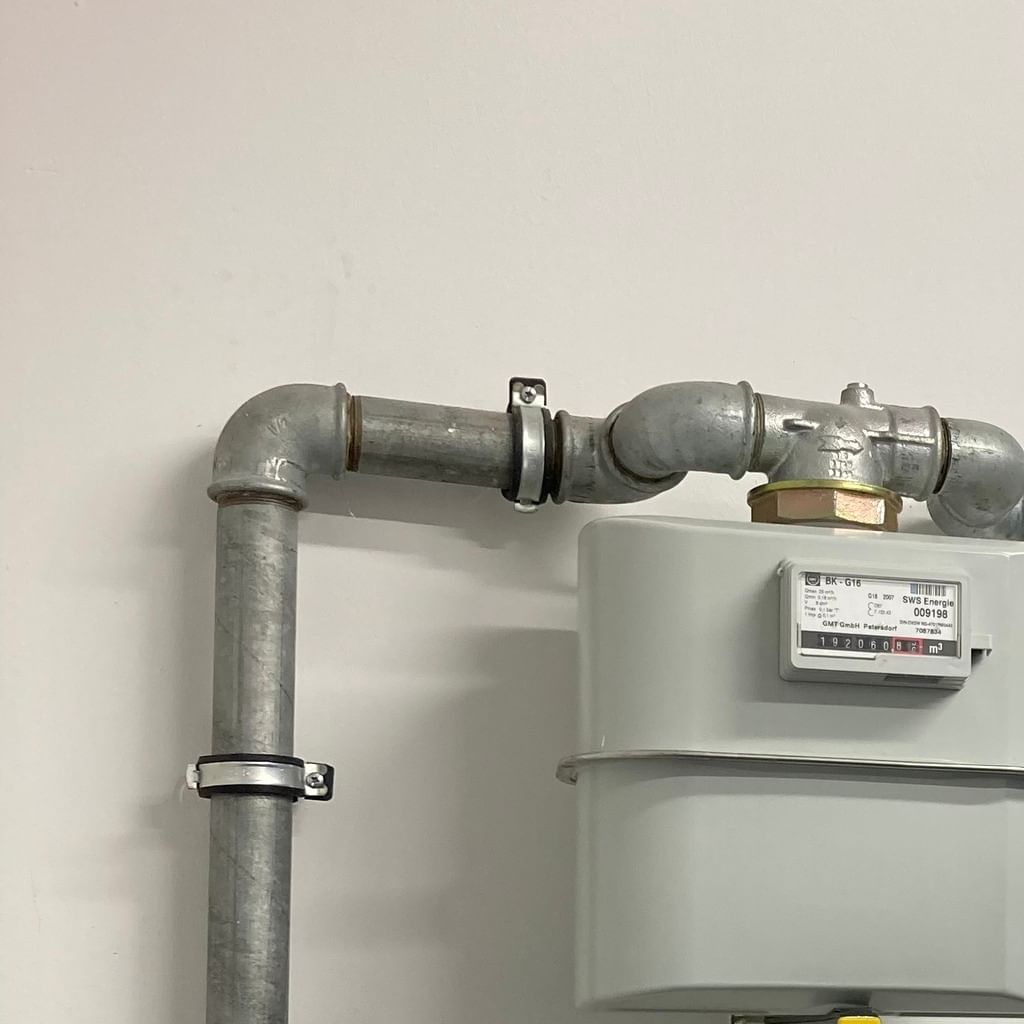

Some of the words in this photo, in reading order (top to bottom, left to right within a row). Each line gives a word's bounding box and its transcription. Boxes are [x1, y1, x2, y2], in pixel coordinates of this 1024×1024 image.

[825, 577, 837, 586] BK
[845, 578, 862, 587] G16
[902, 595, 922, 605] SWS
[923, 597, 955, 609] Energie
[913, 607, 948, 619] 009198
[822, 620, 838, 628] GMT
[839, 621, 860, 630] GmbH
